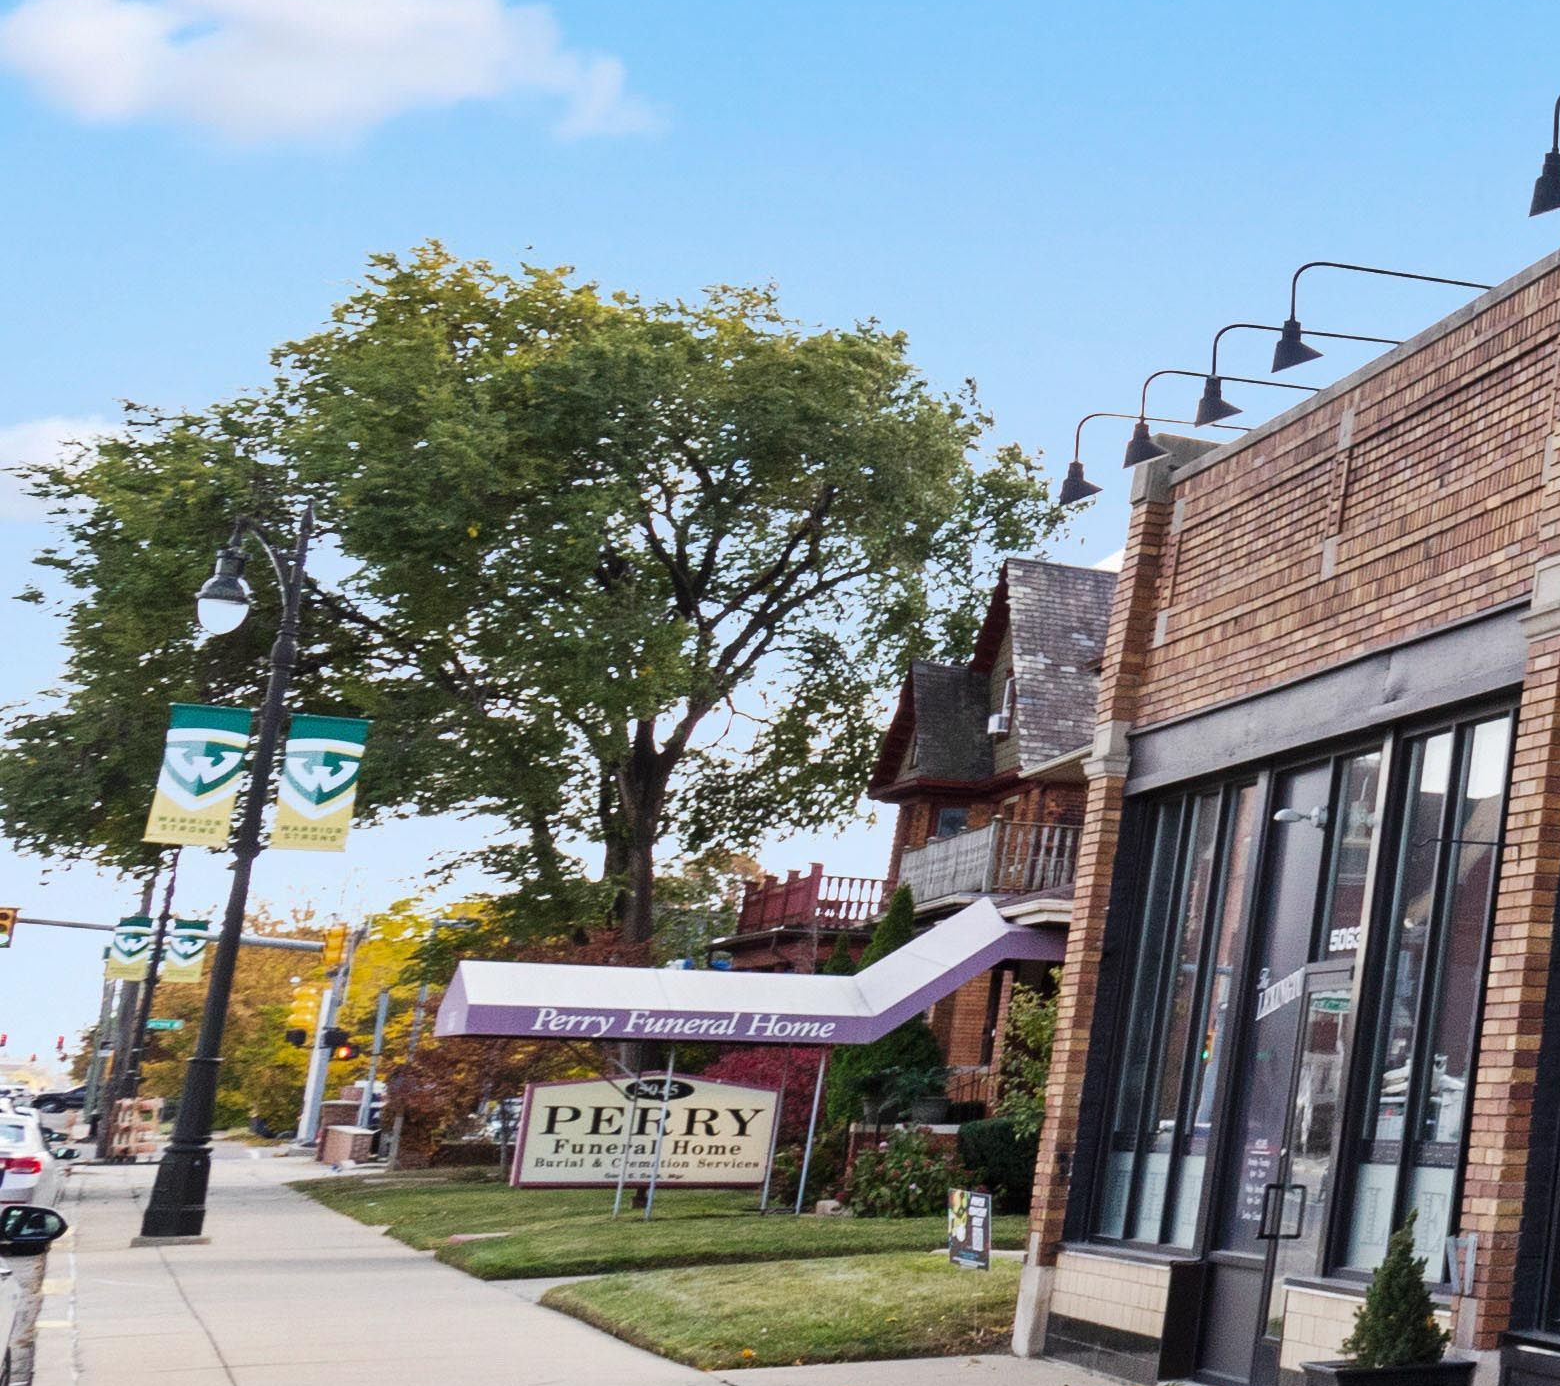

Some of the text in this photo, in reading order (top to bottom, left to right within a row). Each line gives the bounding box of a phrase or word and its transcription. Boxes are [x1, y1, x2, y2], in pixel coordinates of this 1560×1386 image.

[157, 816, 222, 826] WARRIOR
[161, 824, 217, 834] STRONG
[280, 825, 343, 834] WARRIOR
[283, 833, 337, 842] STRONG
[530, 1007, 837, 1039] Perry Funeral Home
[539, 1104, 766, 1138] PERRY
[552, 1138, 743, 1156] Funeral Home
[533, 1157, 586, 1169] Burial
[591, 1158, 602, 1169] &
[698, 1158, 761, 1169] Services
